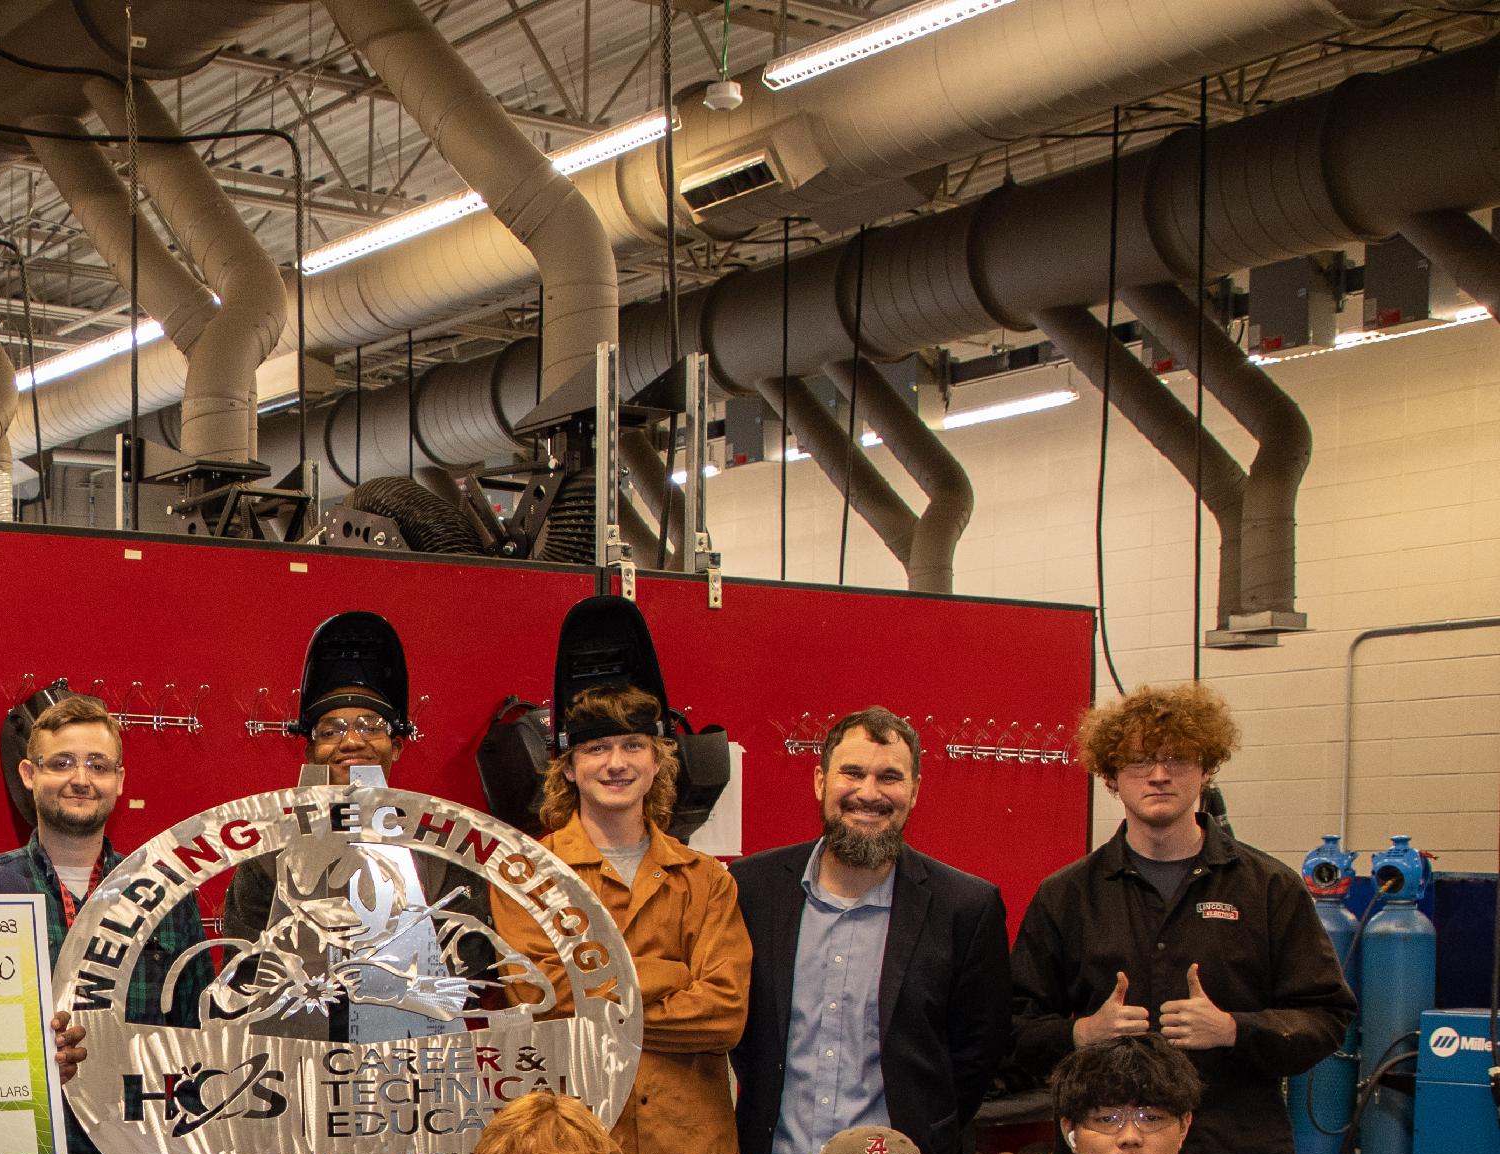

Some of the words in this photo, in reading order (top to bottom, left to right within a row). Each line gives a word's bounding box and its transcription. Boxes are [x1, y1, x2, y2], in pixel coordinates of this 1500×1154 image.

[71, 818, 263, 1012] WELDING
[284, 801, 620, 1005] TECHNOLOGY
[1199, 903, 1231, 912] LINCOLN
[1460, 1036, 1493, 1051] Mille
[322, 1046, 502, 1075] CAREER
[514, 1045, 547, 1072] &
[122, 1052, 288, 1138] HCS
[321, 1075, 581, 1106] TECHNICAL
[327, 1107, 502, 1138] EDUCA
